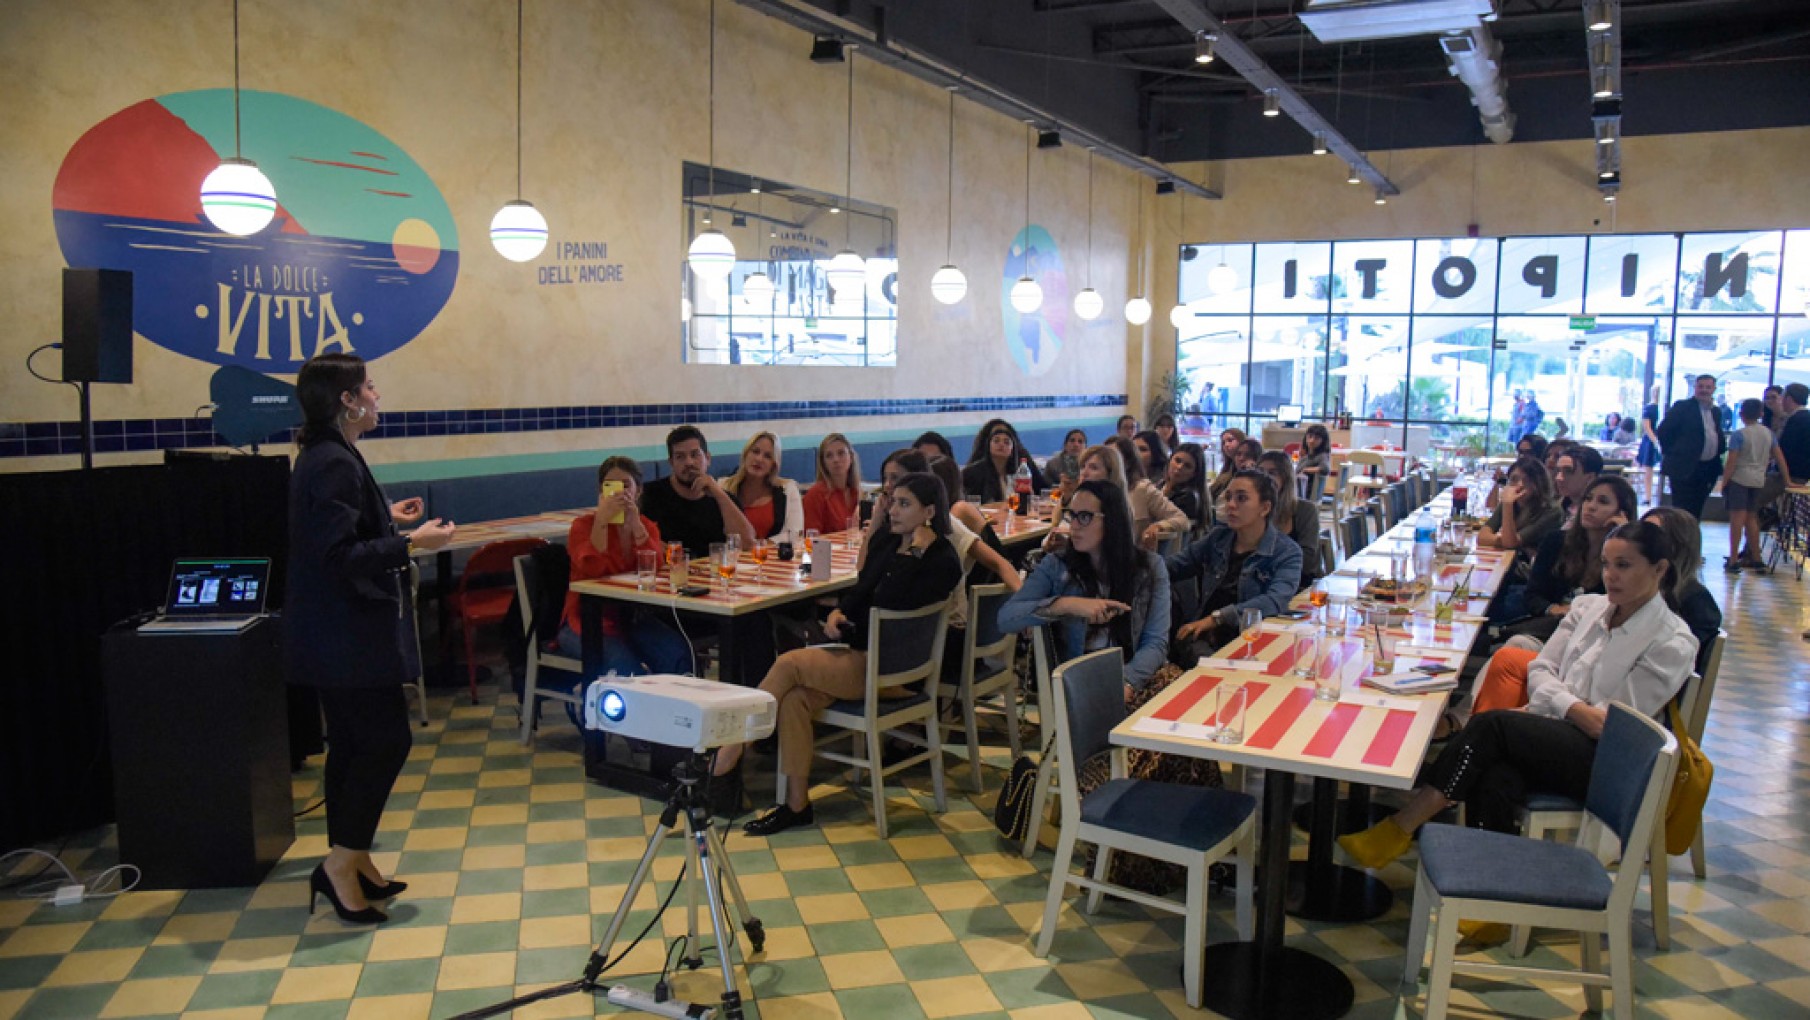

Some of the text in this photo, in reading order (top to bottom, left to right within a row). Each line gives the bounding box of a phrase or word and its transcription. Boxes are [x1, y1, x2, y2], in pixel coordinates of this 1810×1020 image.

[556, 241, 608, 260] I PANINI
[243, 264, 318, 293] LA DOLCE
[538, 264, 625, 285] DELL'AMORE
[216, 282, 357, 361] VITA
